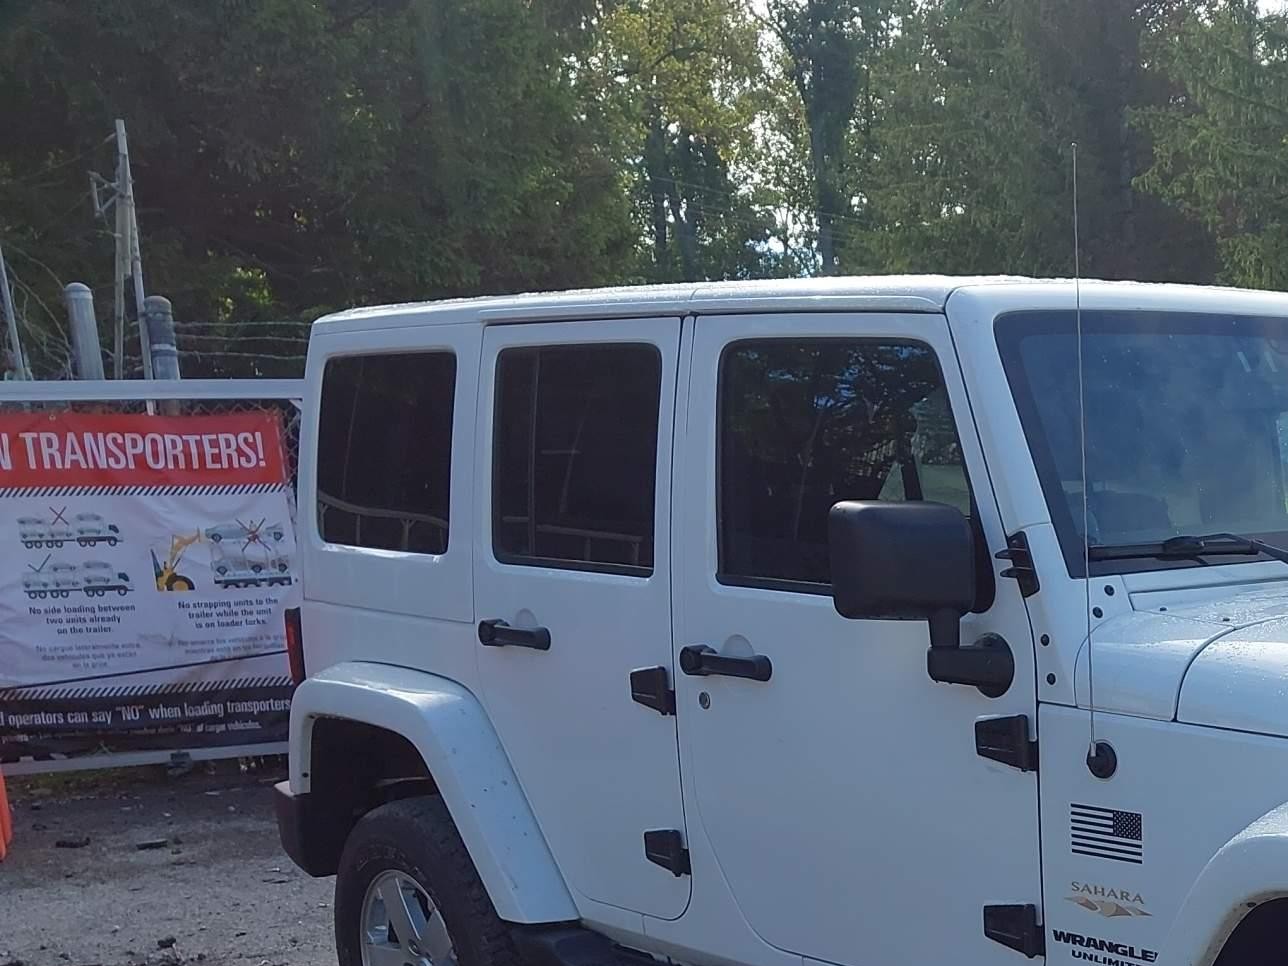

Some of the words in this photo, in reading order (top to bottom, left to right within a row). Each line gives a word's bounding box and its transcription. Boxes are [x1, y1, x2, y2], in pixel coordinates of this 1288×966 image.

[18, 431, 266, 470] TRANSPORTERS!
[29, 606, 42, 615] No
[44, 604, 61, 614] side
[64, 604, 96, 615] loading
[97, 603, 136, 612] between
[178, 601, 190, 609] No
[192, 600, 232, 610] strapping
[234, 599, 254, 607] units
[255, 598, 264, 606] to
[265, 597, 278, 605] the
[188, 610, 213, 619] trailer
[215, 608, 239, 617] while
[241, 608, 254, 616] the
[256, 607, 272, 615] unit
[46, 616, 63, 625] two
[66, 615, 87, 624] units
[89, 614, 121, 624] already
[217, 619, 243, 627] loader
[70, 625, 84, 634] the
[8, 711, 64, 728] operators
[67, 711, 88, 724] can
[91, 710, 112, 725] say
[148, 703, 181, 719] when
[184, 700, 224, 718] loading
[1071, 880, 1145, 905] SAHARA
